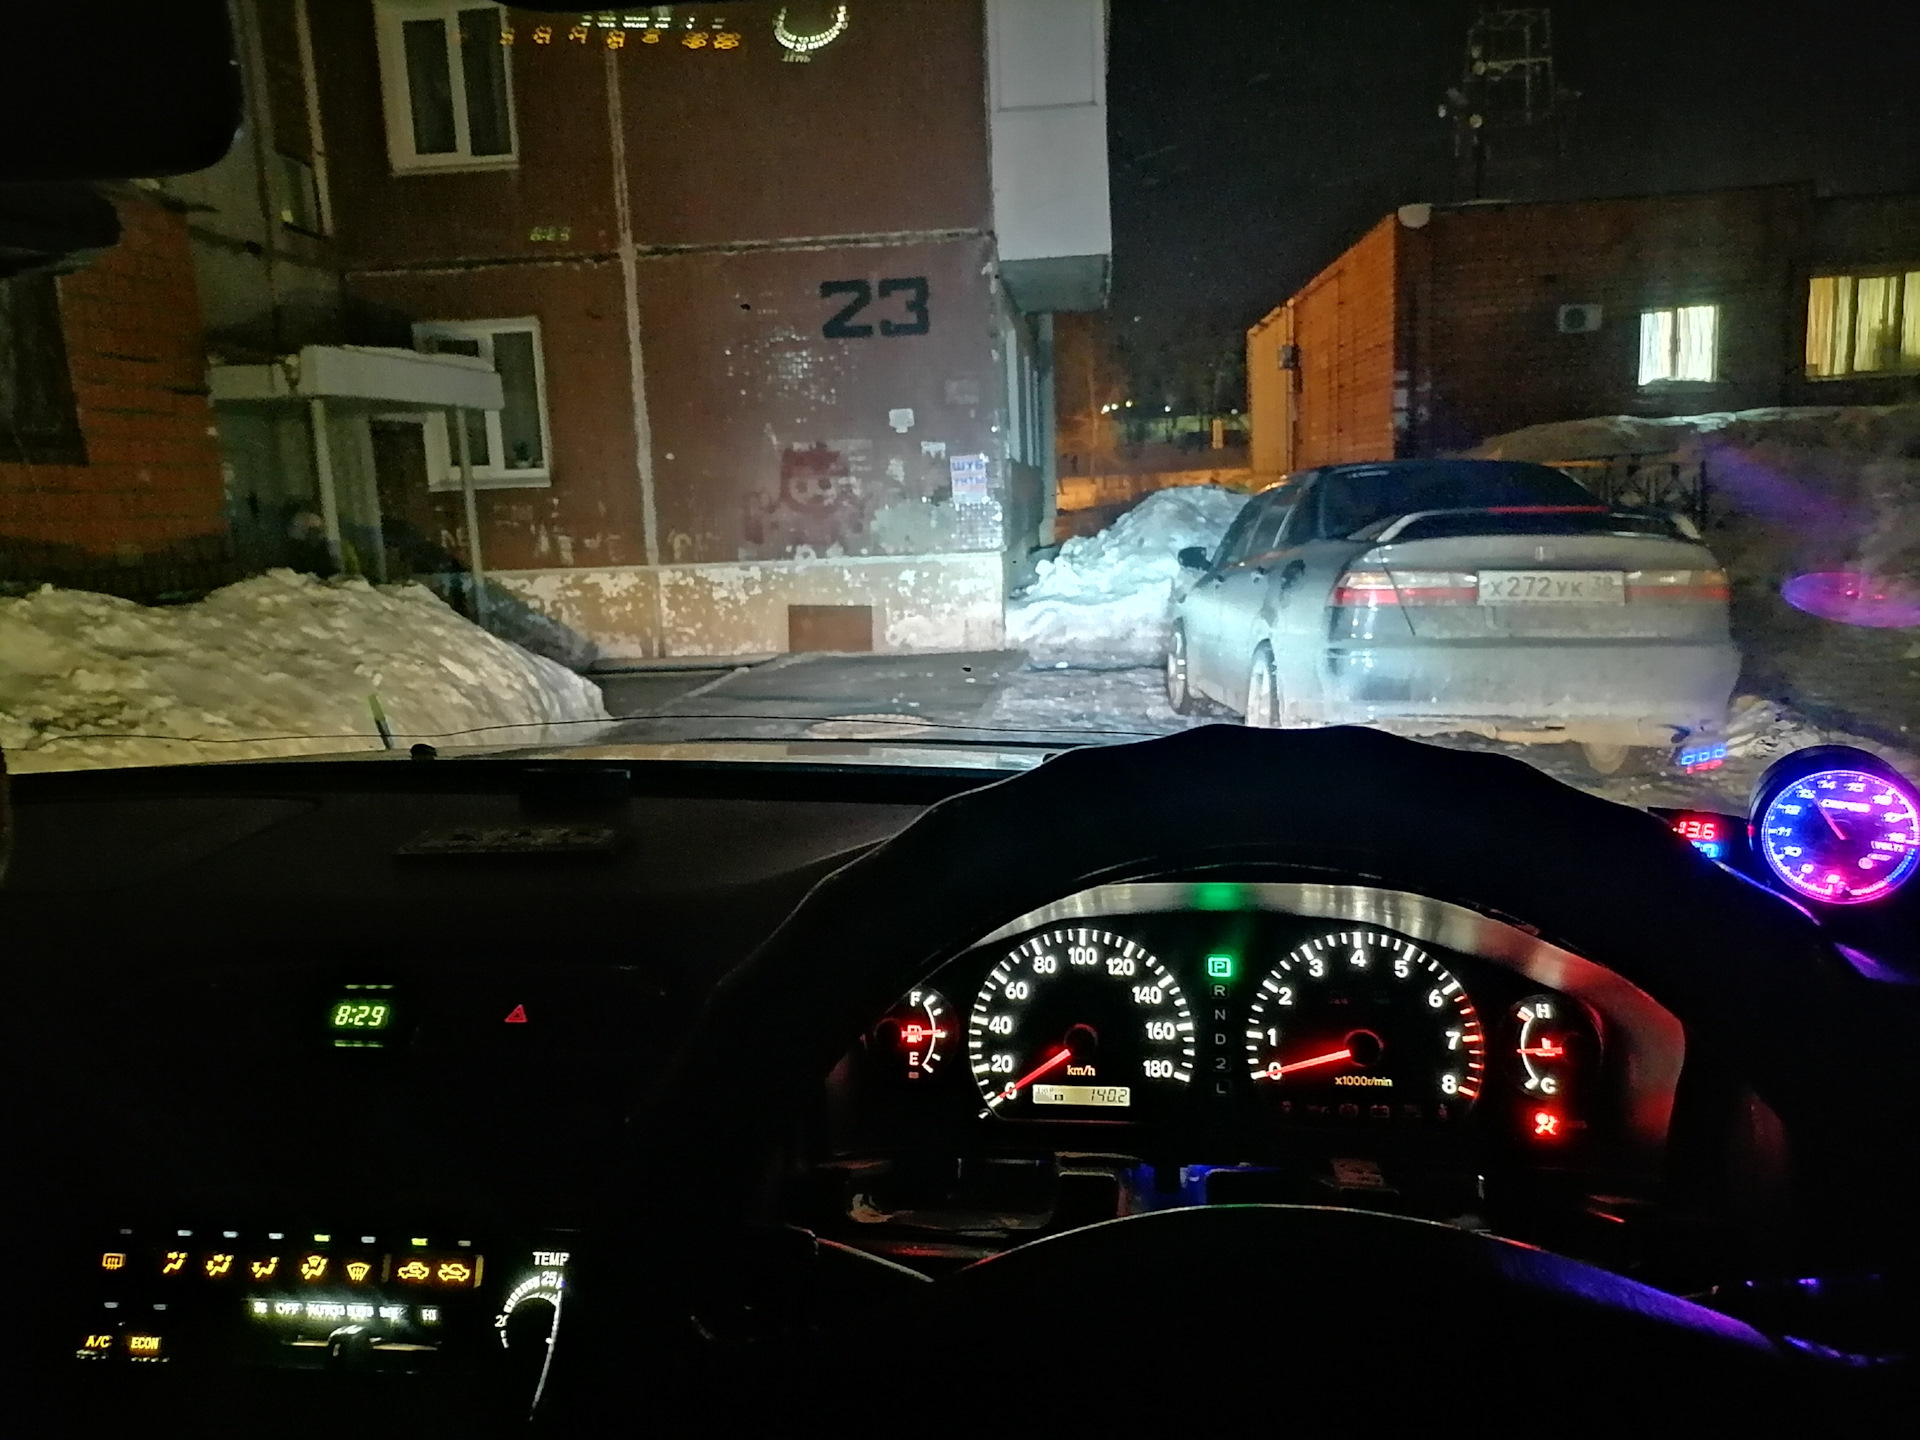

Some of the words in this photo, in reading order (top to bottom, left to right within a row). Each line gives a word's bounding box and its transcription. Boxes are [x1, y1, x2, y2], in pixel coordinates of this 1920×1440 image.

[819, 276, 930, 338] 23
[1033, 956, 1056, 974] 80
[1068, 947, 1098, 966] 100
[1350, 949, 1367, 968] 4
[1106, 958, 1135, 976] 120
[1308, 959, 1324, 977] 3
[1394, 960, 1409, 978] 5
[910, 991, 922, 1007] F
[1005, 981, 1028, 1000] 60
[1132, 986, 1162, 1004] 140
[1214, 984, 1227, 997] R
[1278, 987, 1293, 1005] 2
[1428, 990, 1443, 1008] 6
[335, 1005, 386, 1026] 8:29
[1214, 1009, 1227, 1021] N
[1535, 1003, 1551, 1019] H
[988, 1016, 1012, 1034] 40
[1145, 1022, 1175, 1040] 160
[1215, 1033, 1227, 1045] D
[1266, 1028, 1277, 1047] 1
[1445, 1031, 1461, 1050] 7
[909, 1051, 919, 1066] E
[991, 1055, 1013, 1072] 20
[1215, 1057, 1227, 1069] 2
[1066, 1064, 1096, 1077] km/h
[1143, 1060, 1173, 1078] 180
[1215, 1082, 1227, 1094] L
[1335, 1075, 1394, 1088] x1000r/min
[1441, 1075, 1457, 1094] 8
[1540, 1077, 1556, 1094] C
[532, 1251, 570, 1266] TEMP
[540, 1270, 558, 1287] 25
[275, 1302, 302, 1316] OFF
[85, 1335, 113, 1348] A/C
[130, 1336, 161, 1349] ECON
